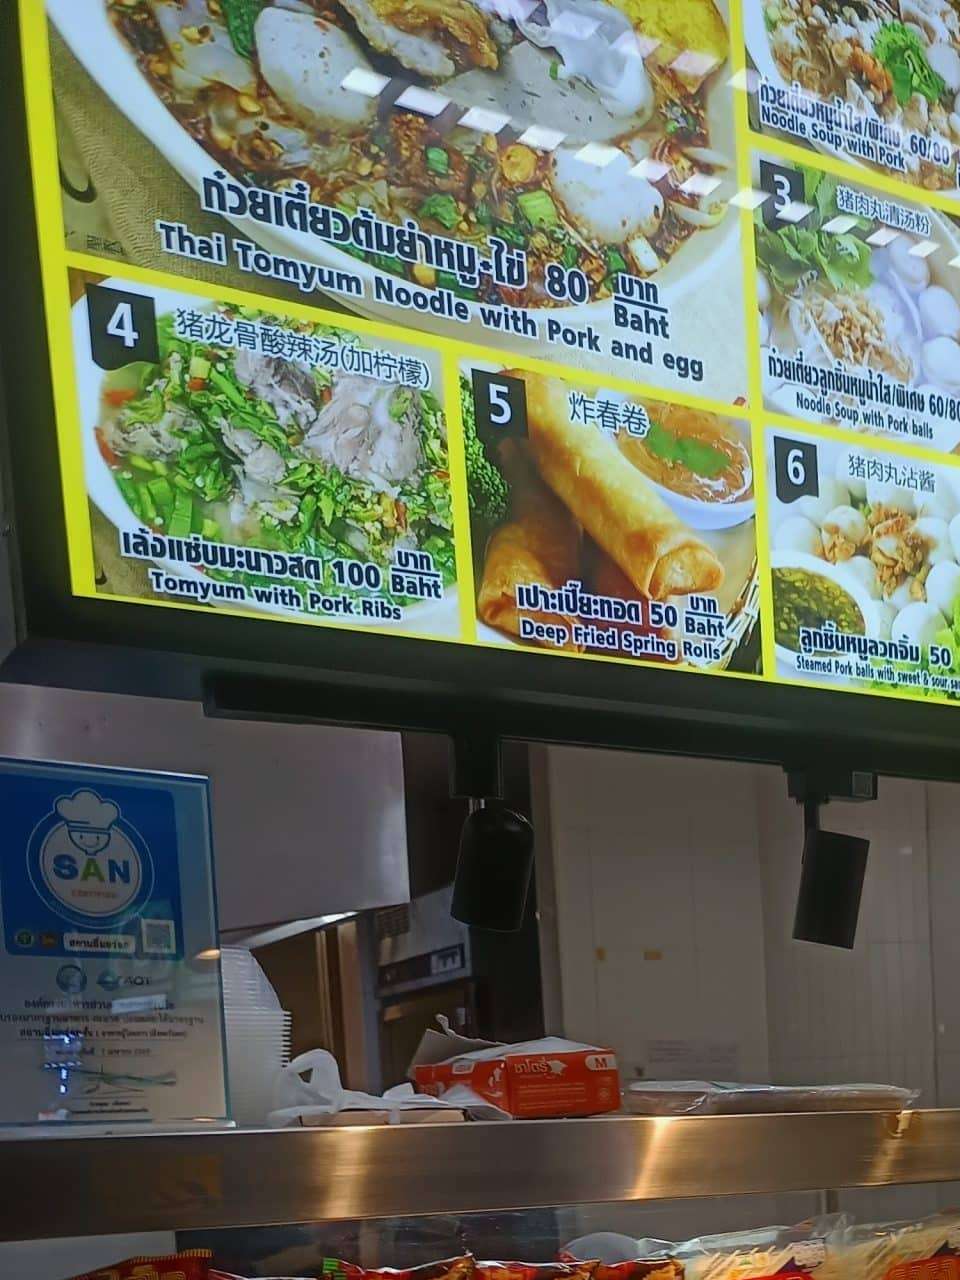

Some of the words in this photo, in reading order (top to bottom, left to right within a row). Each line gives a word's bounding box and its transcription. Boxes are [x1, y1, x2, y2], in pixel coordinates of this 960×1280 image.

[762, 106, 805, 135] Noodle
[812, 123, 841, 149] Soup
[847, 136, 874, 159] with
[879, 148, 905, 170] Pork
[910, 135, 950, 166] 60/80
[774, 175, 791, 213] 3
[837, 187, 929, 234] 猪肉丸清汤粉
[160, 223, 223, 261] Thai
[237, 242, 361, 290] Tomyum
[375, 276, 468, 320] Noodle
[480, 307, 537, 336] with
[548, 318, 600, 351] Pork
[612, 340, 653, 364] and
[662, 353, 704, 380] egg
[546, 266, 586, 303] 80
[619, 276, 657, 304] บาท
[106, 302, 138, 347] 4
[614, 302, 669, 339] Baht
[177, 308, 430, 387] 猪龙骨酸辣汤(加柠檬)
[489, 384, 512, 424] 5
[569, 391, 648, 435] 炸春卷
[796, 392, 830, 414] Noodle
[835, 402, 858, 422] Soup
[862, 407, 885, 427] with
[888, 413, 910, 433] Pork
[912, 419, 933, 439] balls
[787, 449, 806, 485] 6
[848, 454, 936, 494] 猪肉丸沾酱
[333, 560, 380, 588] 100
[398, 550, 431, 571] บาท
[391, 575, 441, 598] Baht
[152, 572, 245, 601] Tomyum
[254, 589, 300, 608] with
[310, 593, 353, 614] Pork
[362, 599, 401, 620] Ribs
[651, 605, 677, 626] 50
[690, 596, 717, 613] บาท
[522, 620, 566, 643] Deep
[575, 626, 615, 649] Fried
[623, 633, 676, 657] Spring
[683, 641, 721, 660] Rolls
[685, 617, 725, 637] Baht
[801, 623, 919, 662] ลูกชิ้นหมูลวกจิ้ม
[930, 647, 950, 666] 50
[797, 656, 832, 673] Steamed
[835, 660, 853, 676] Pork
[856, 662, 874, 678] balls
[877, 665, 895, 681] with
[898, 670, 920, 685] sweet
[932, 677, 949, 688] sour
[53, 854, 130, 884] SAN
[594, 1058, 608, 1069] M
